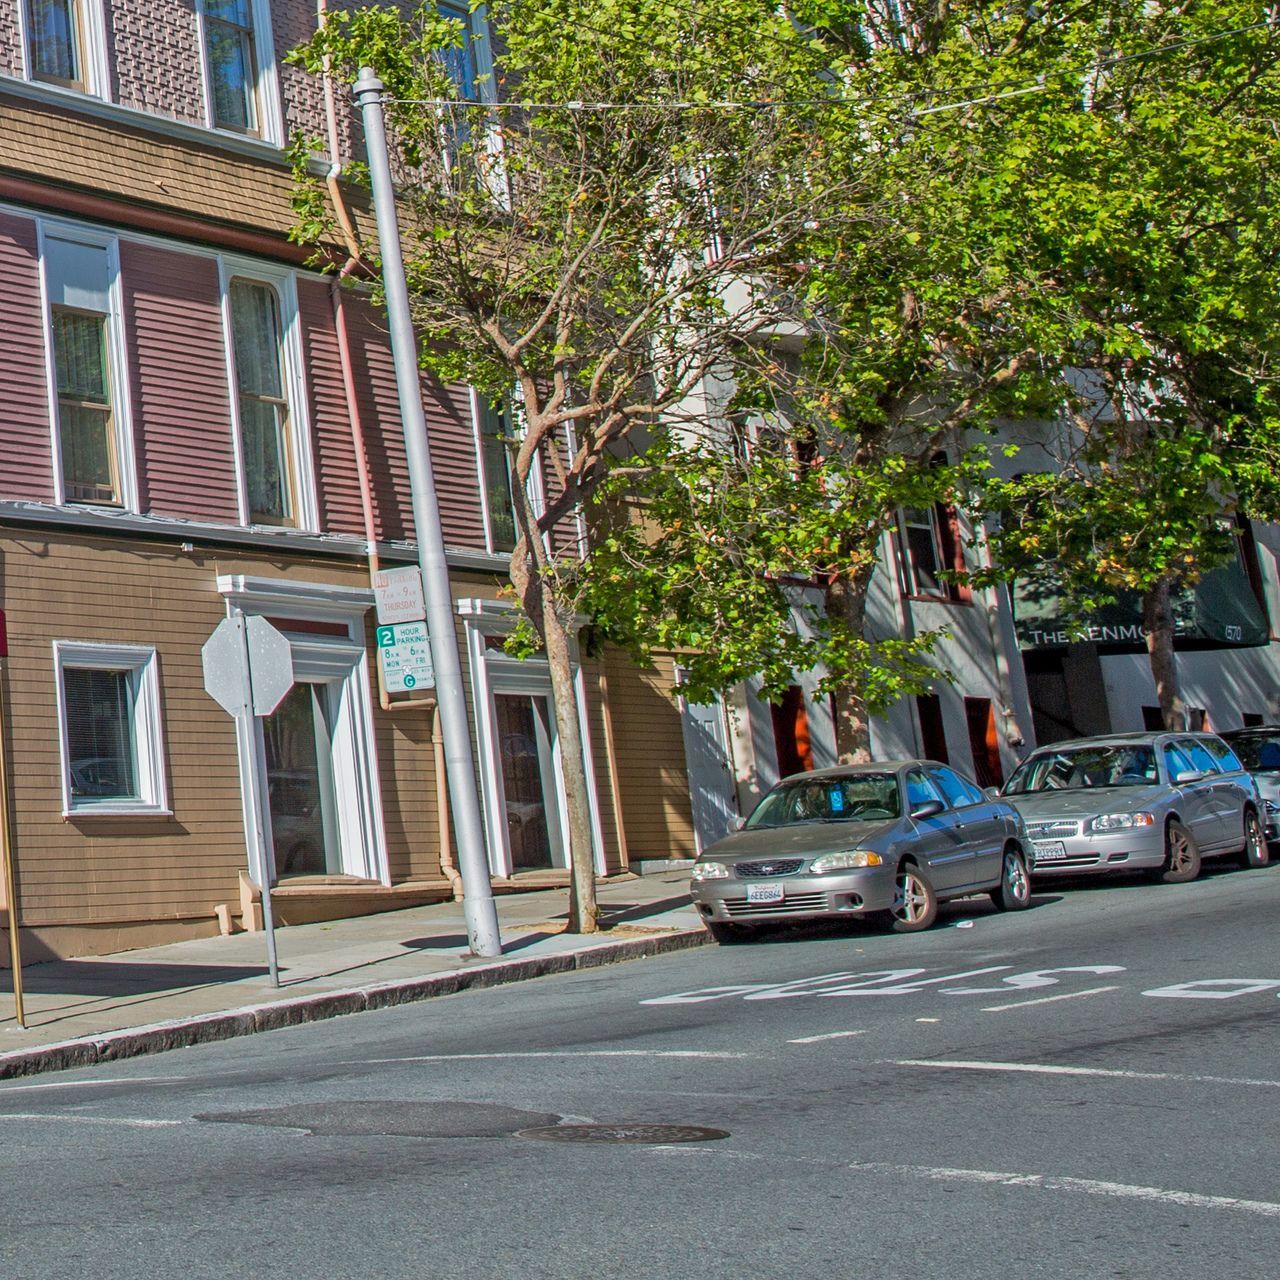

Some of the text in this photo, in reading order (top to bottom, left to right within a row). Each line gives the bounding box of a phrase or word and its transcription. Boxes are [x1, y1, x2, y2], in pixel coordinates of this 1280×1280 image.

[383, 600, 417, 611] THURSDAY
[381, 627, 419, 645] 2 HOUR
[396, 634, 426, 646] PARKING
[1029, 630, 1069, 644] THE
[416, 656, 426, 664] FRI
